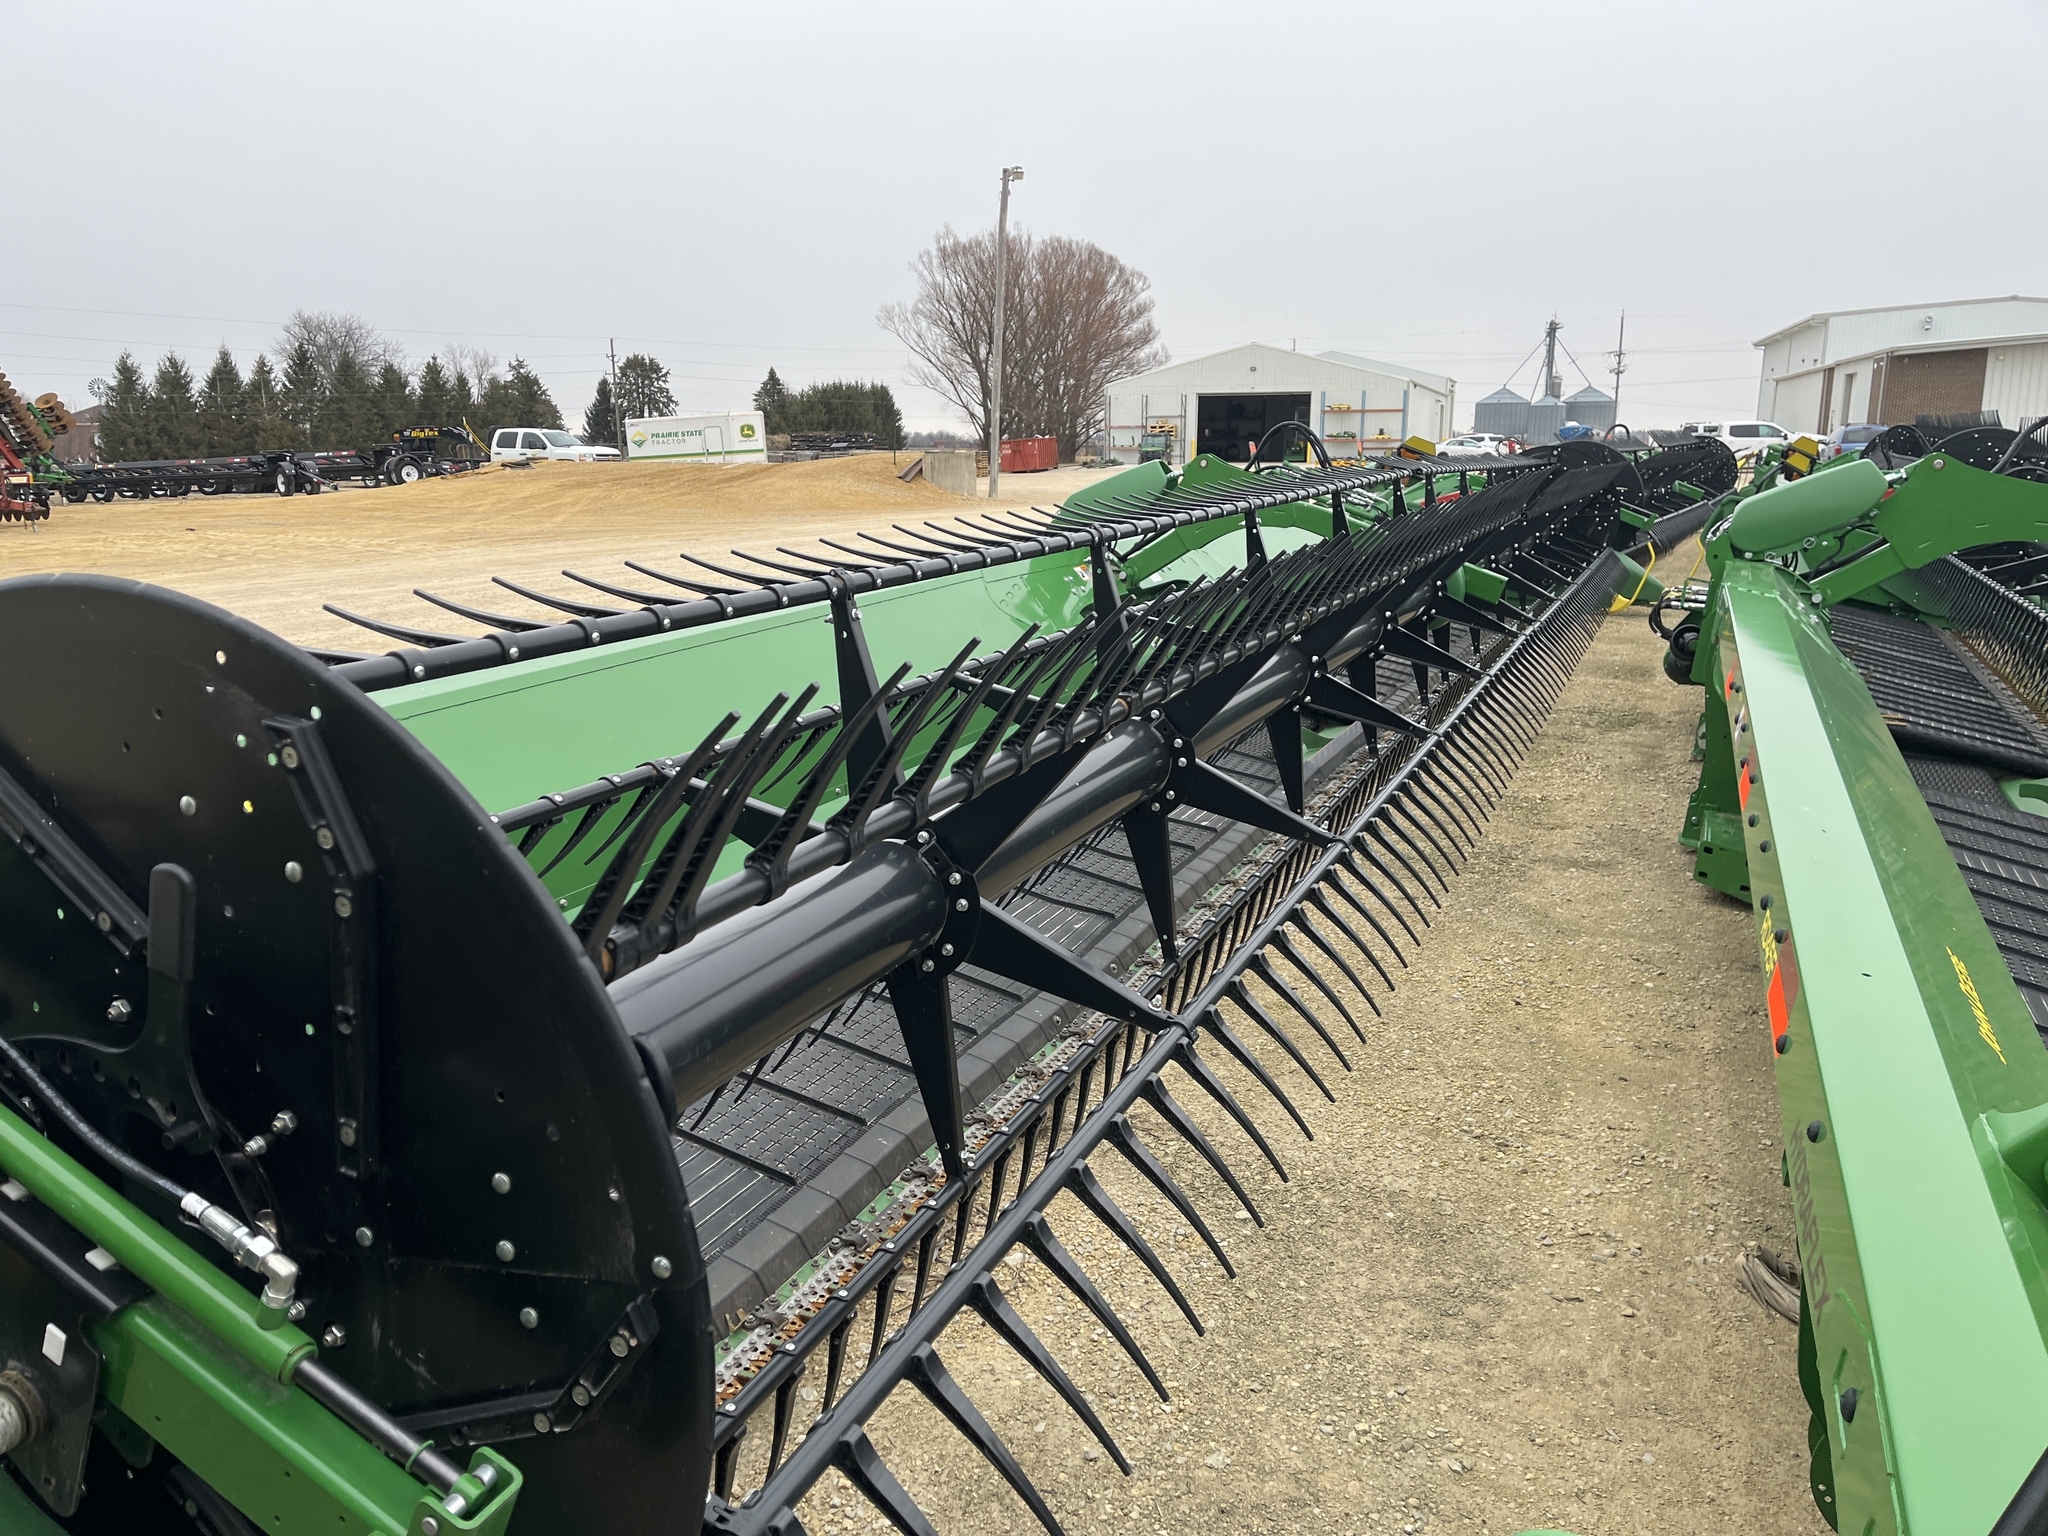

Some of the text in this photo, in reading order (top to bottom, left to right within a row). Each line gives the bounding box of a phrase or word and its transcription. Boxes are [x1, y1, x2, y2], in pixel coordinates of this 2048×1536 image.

[651, 430, 703, 439] PRAIRIE STATE
[1945, 946, 2007, 1066] JOHN DEERE
